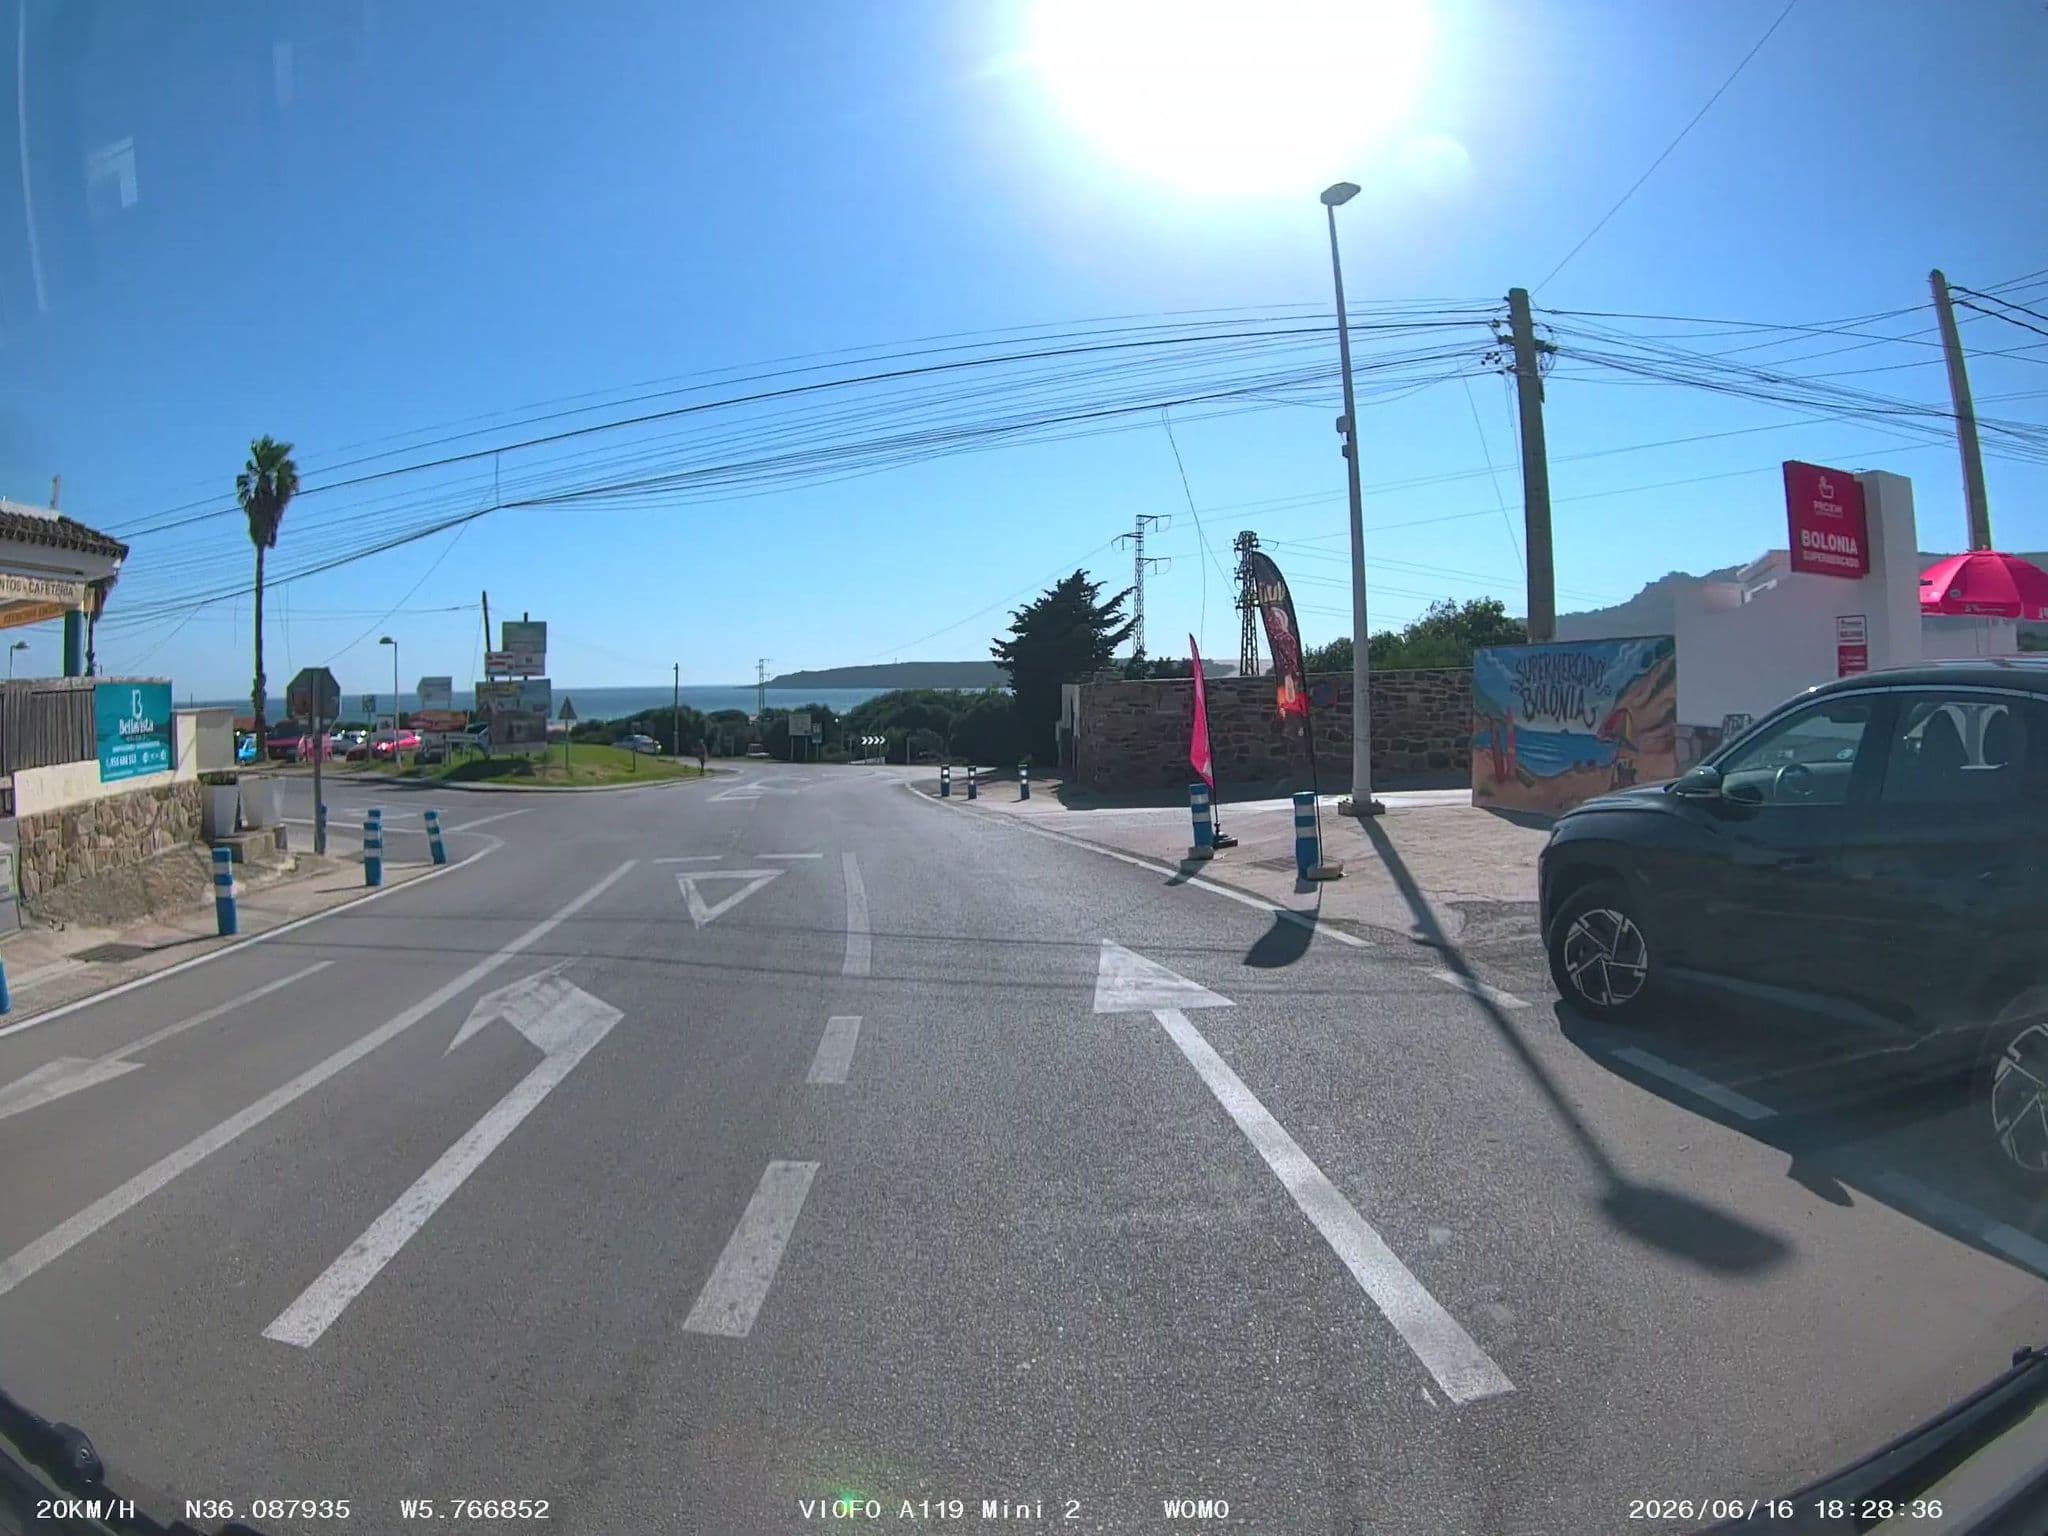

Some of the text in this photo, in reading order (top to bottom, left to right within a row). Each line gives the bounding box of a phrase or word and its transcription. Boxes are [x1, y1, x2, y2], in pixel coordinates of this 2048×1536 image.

[1800, 529, 1858, 555] BOLONIA
[1514, 651, 1607, 691] SUPERMERCADO
[1520, 686, 1594, 727] BOLONIA
